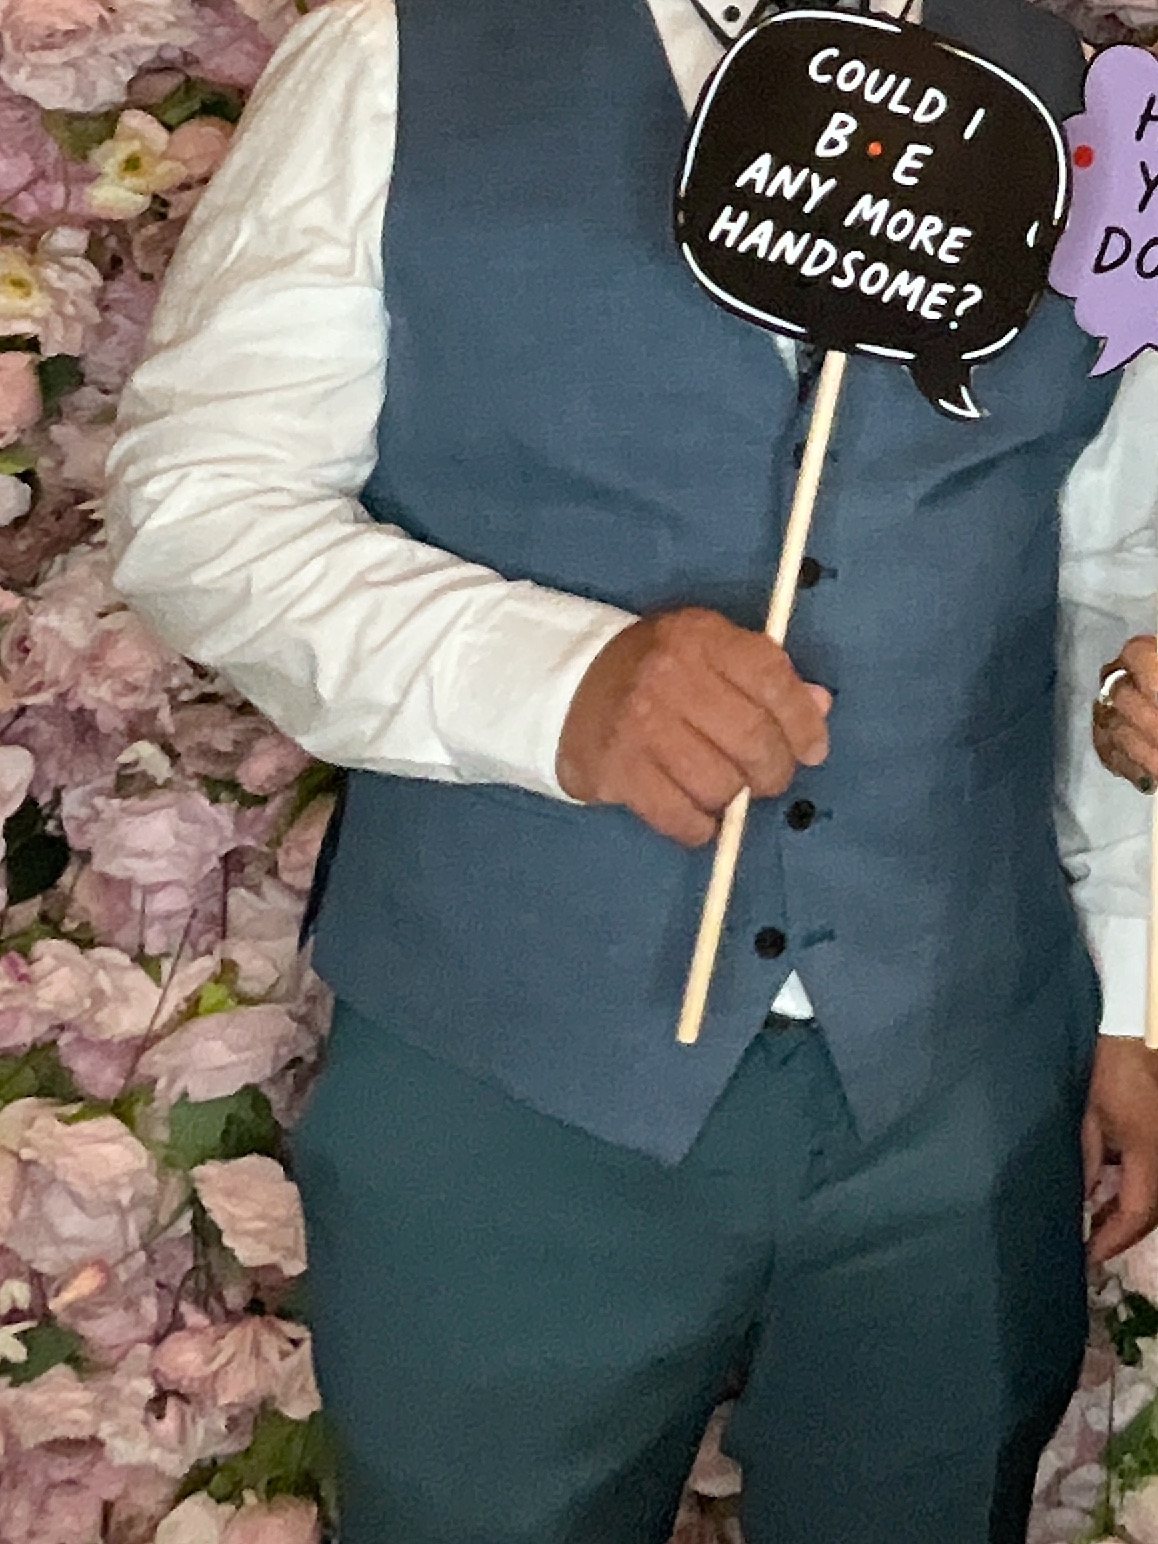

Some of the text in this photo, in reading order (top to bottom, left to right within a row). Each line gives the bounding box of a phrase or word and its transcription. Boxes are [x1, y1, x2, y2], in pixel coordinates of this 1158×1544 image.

[807, 46, 986, 141] COULD I
[733, 151, 974, 265] ANY MORE
[707, 204, 984, 332] HANDSOME?
